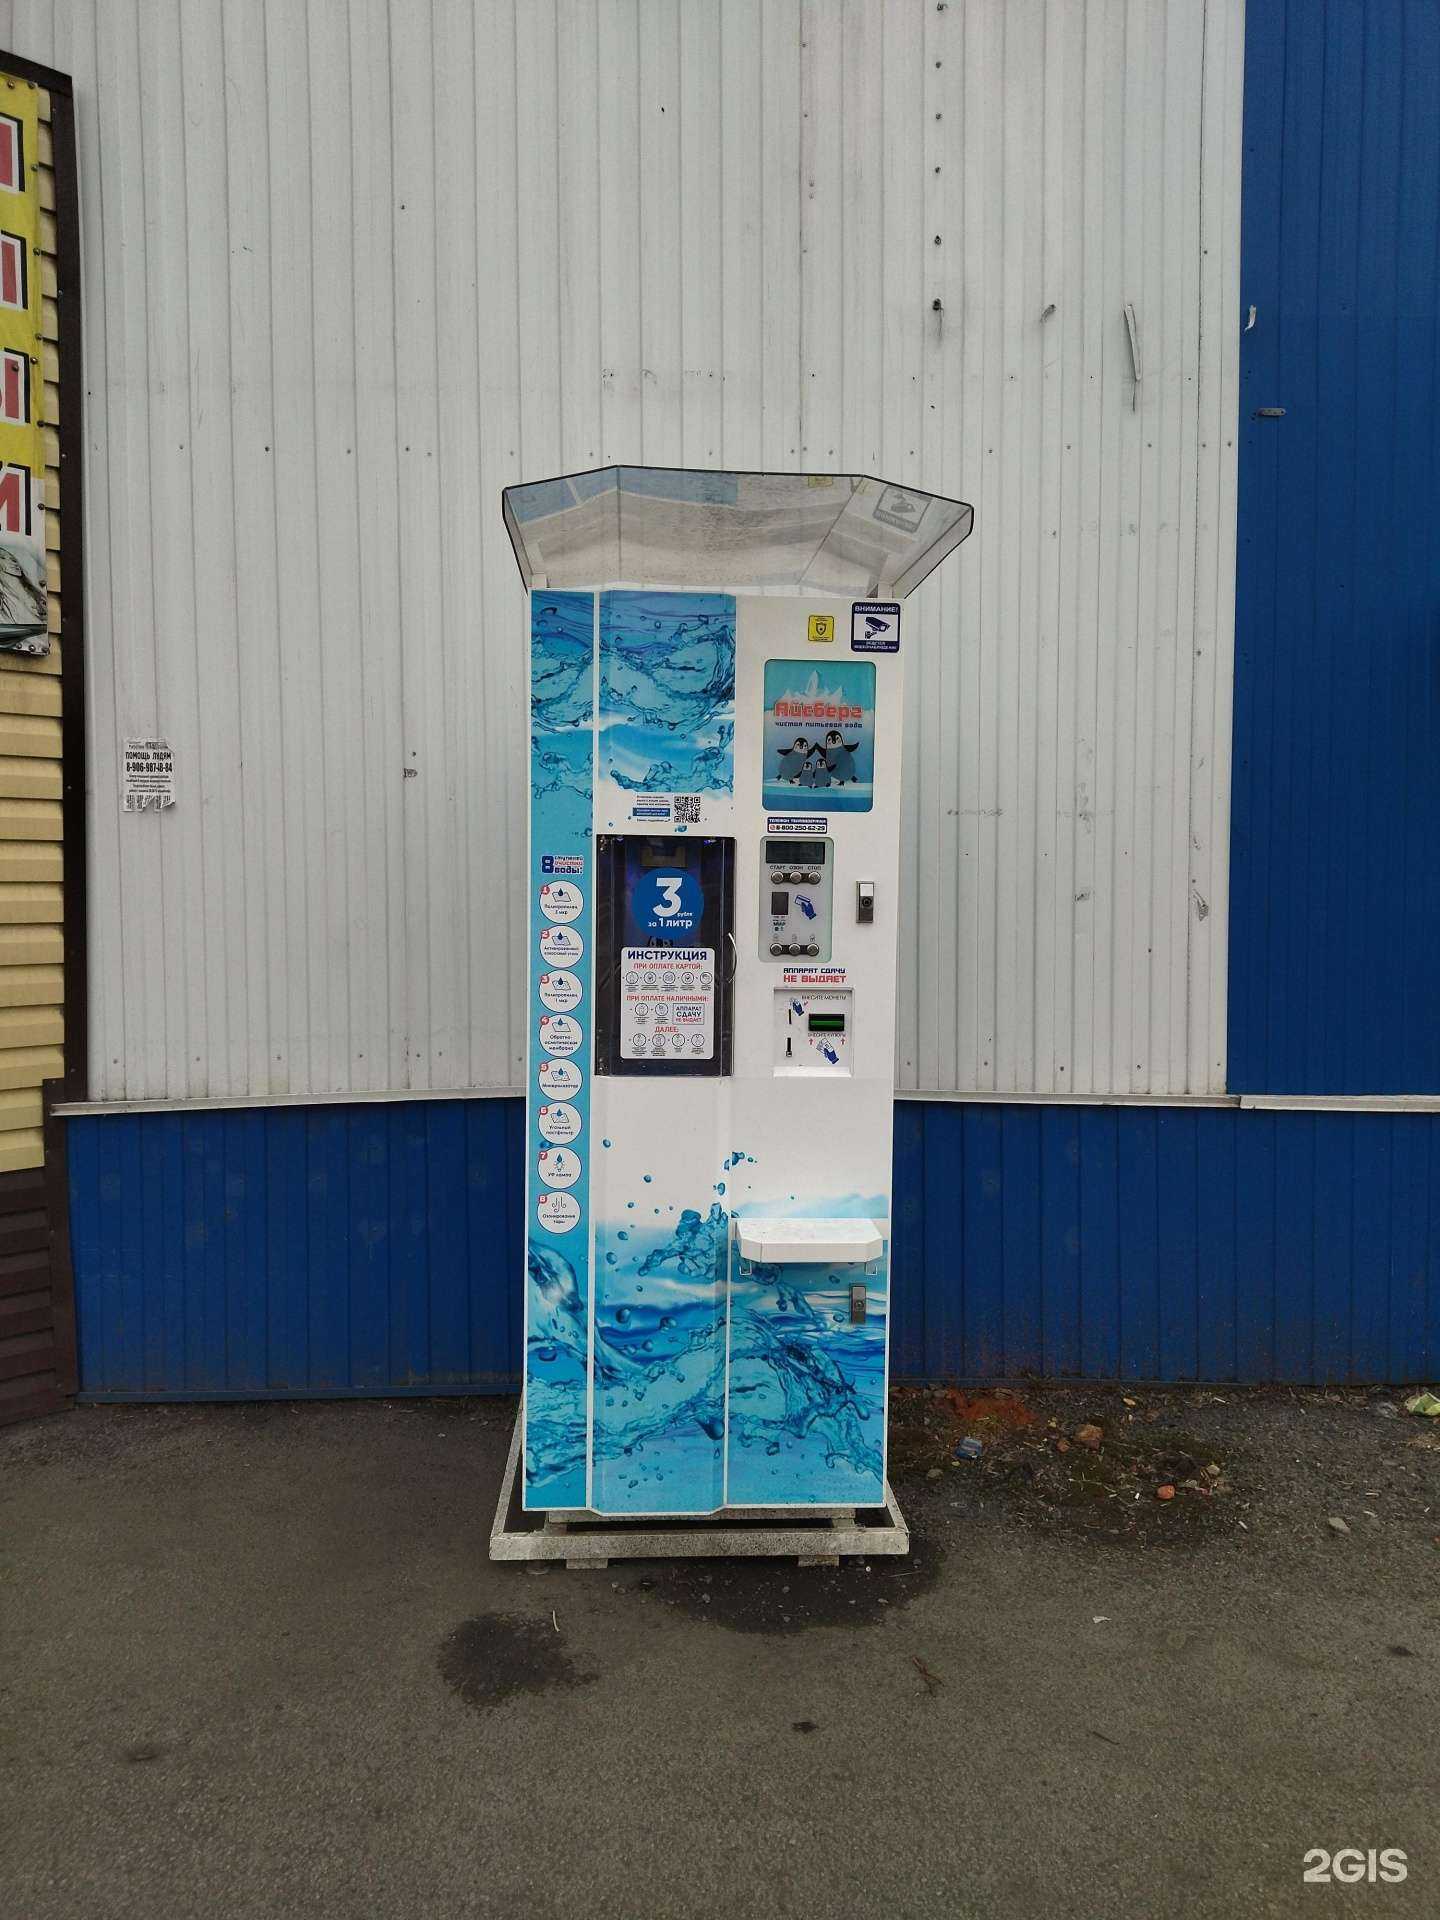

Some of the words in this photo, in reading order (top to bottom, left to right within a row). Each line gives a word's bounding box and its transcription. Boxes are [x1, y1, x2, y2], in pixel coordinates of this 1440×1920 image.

[854, 605, 899, 613] ВНИМАНИЕ!
[774, 701, 863, 720] Айсберг
[125, 751, 151, 761] ПОМОЩЬ
[652, 877, 683, 917] 3
[658, 918, 664, 927] 1
[665, 919, 693, 929] литр
[627, 950, 708, 961] ИНСТРУКЦИЯ
[675, 963, 703, 971] КАРТОЙ:
[783, 975, 798, 983] НЕ
[801, 975, 847, 983] ВЫДАЕТ
[666, 995, 709, 1003] НАЛИЧНЫМИ:
